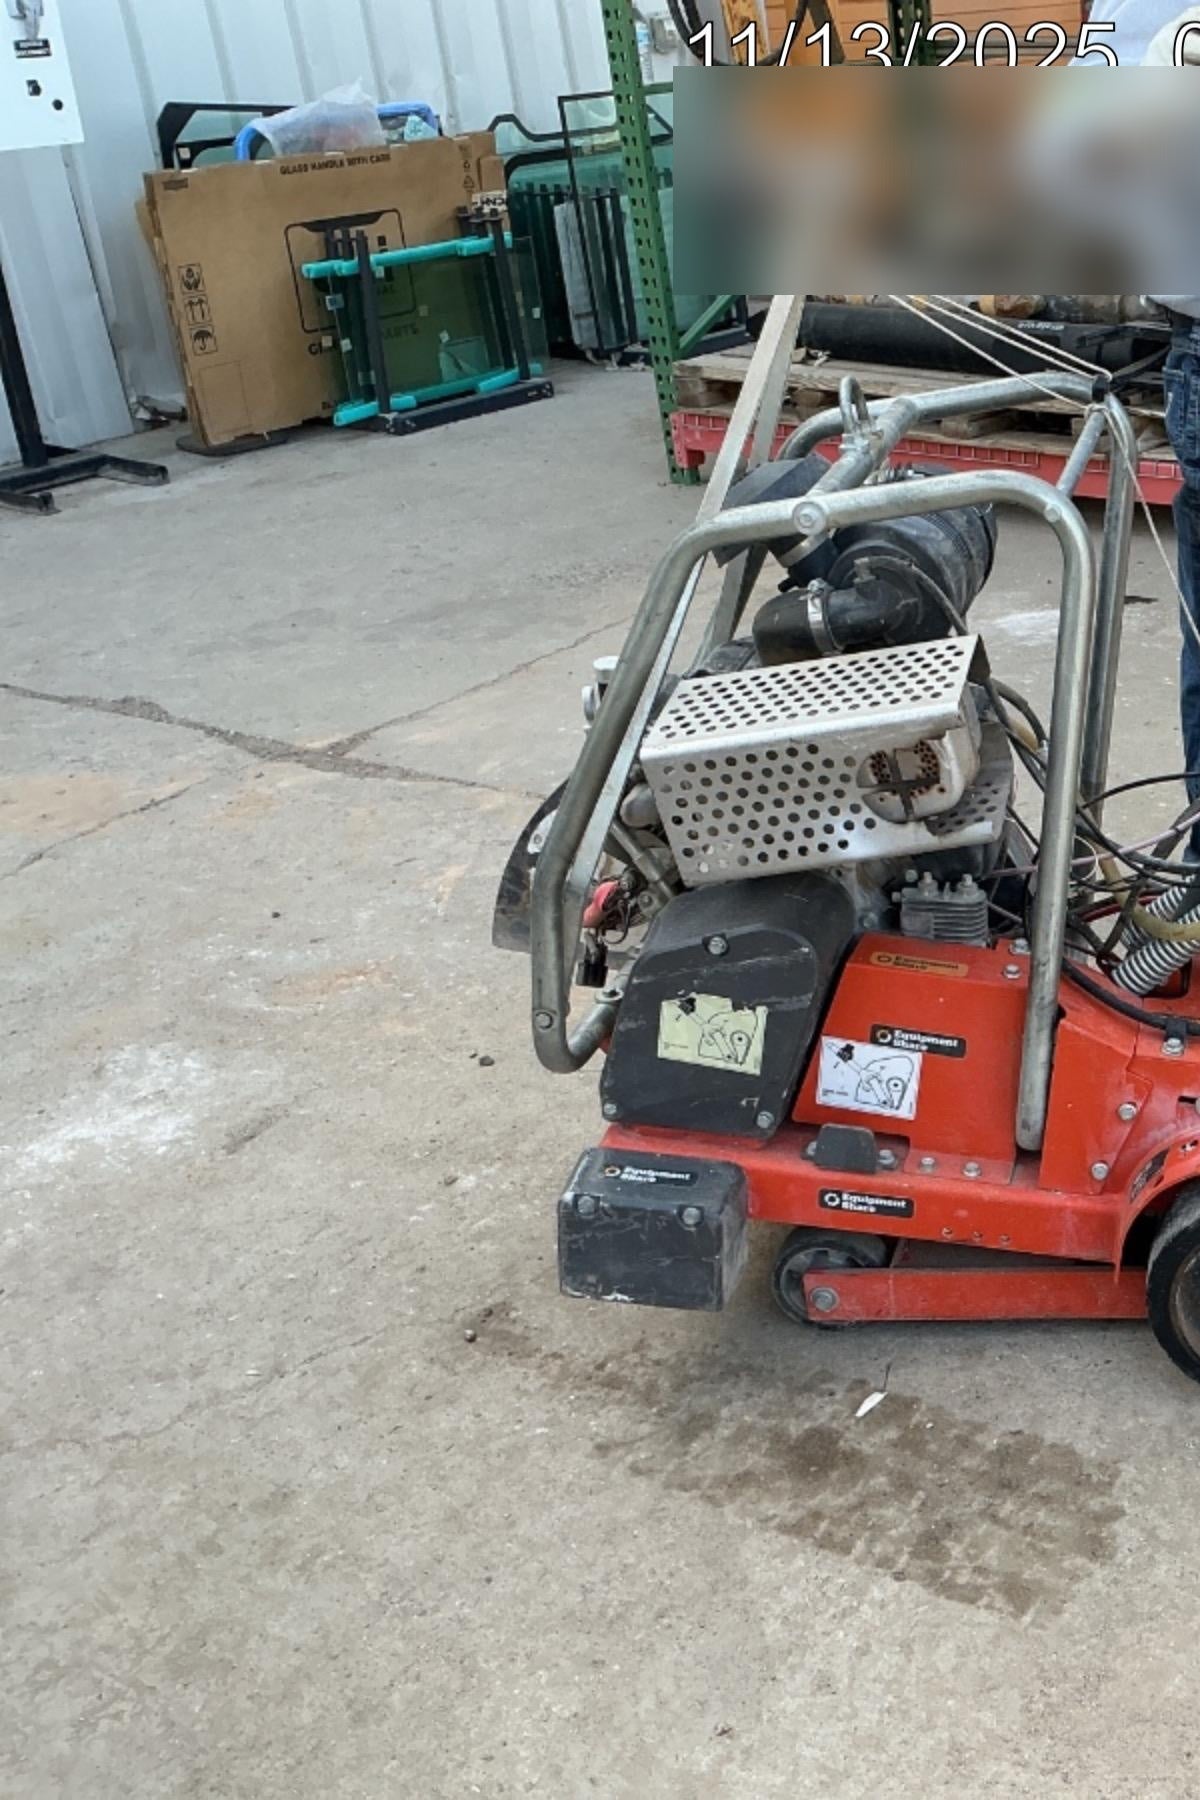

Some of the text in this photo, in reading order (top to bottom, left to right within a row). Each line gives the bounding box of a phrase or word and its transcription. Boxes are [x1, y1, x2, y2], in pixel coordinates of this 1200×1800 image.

[893, 1029, 959, 1048] Equipment
[893, 1038, 929, 1052] Share
[623, 1165, 691, 1181] Equipment
[841, 1192, 907, 1208] Equipment
[841, 1201, 877, 1213] Share
